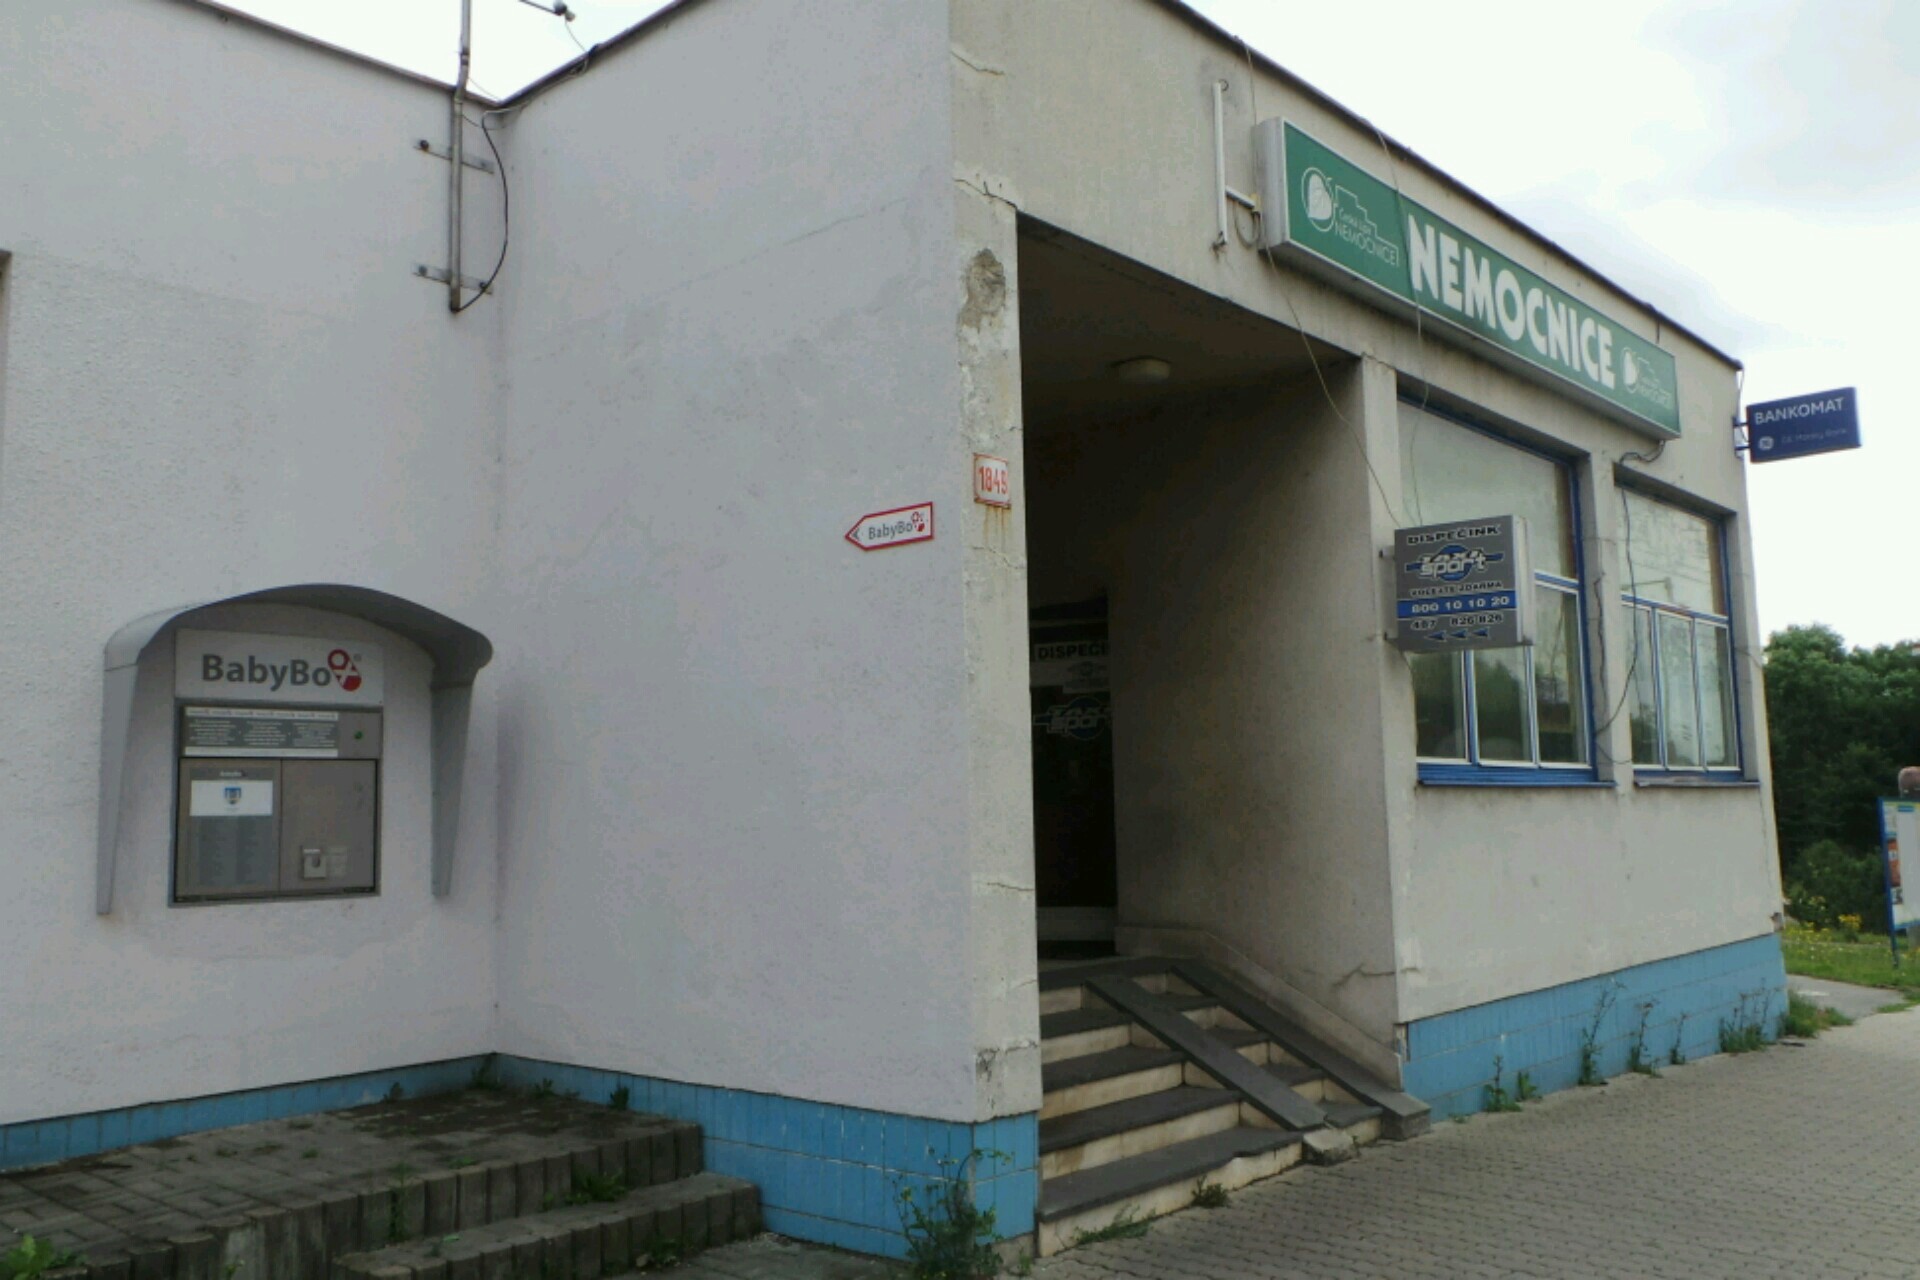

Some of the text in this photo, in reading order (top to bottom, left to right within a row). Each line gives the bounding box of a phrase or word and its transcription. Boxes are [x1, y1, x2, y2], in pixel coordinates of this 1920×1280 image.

[1407, 213, 1617, 390] NEMOCNICE
[1754, 397, 1845, 425] BANKOMAT
[1445, 600, 1463, 611] 10
[1468, 598, 1487, 609] 10
[1490, 596, 1510, 608] 20
